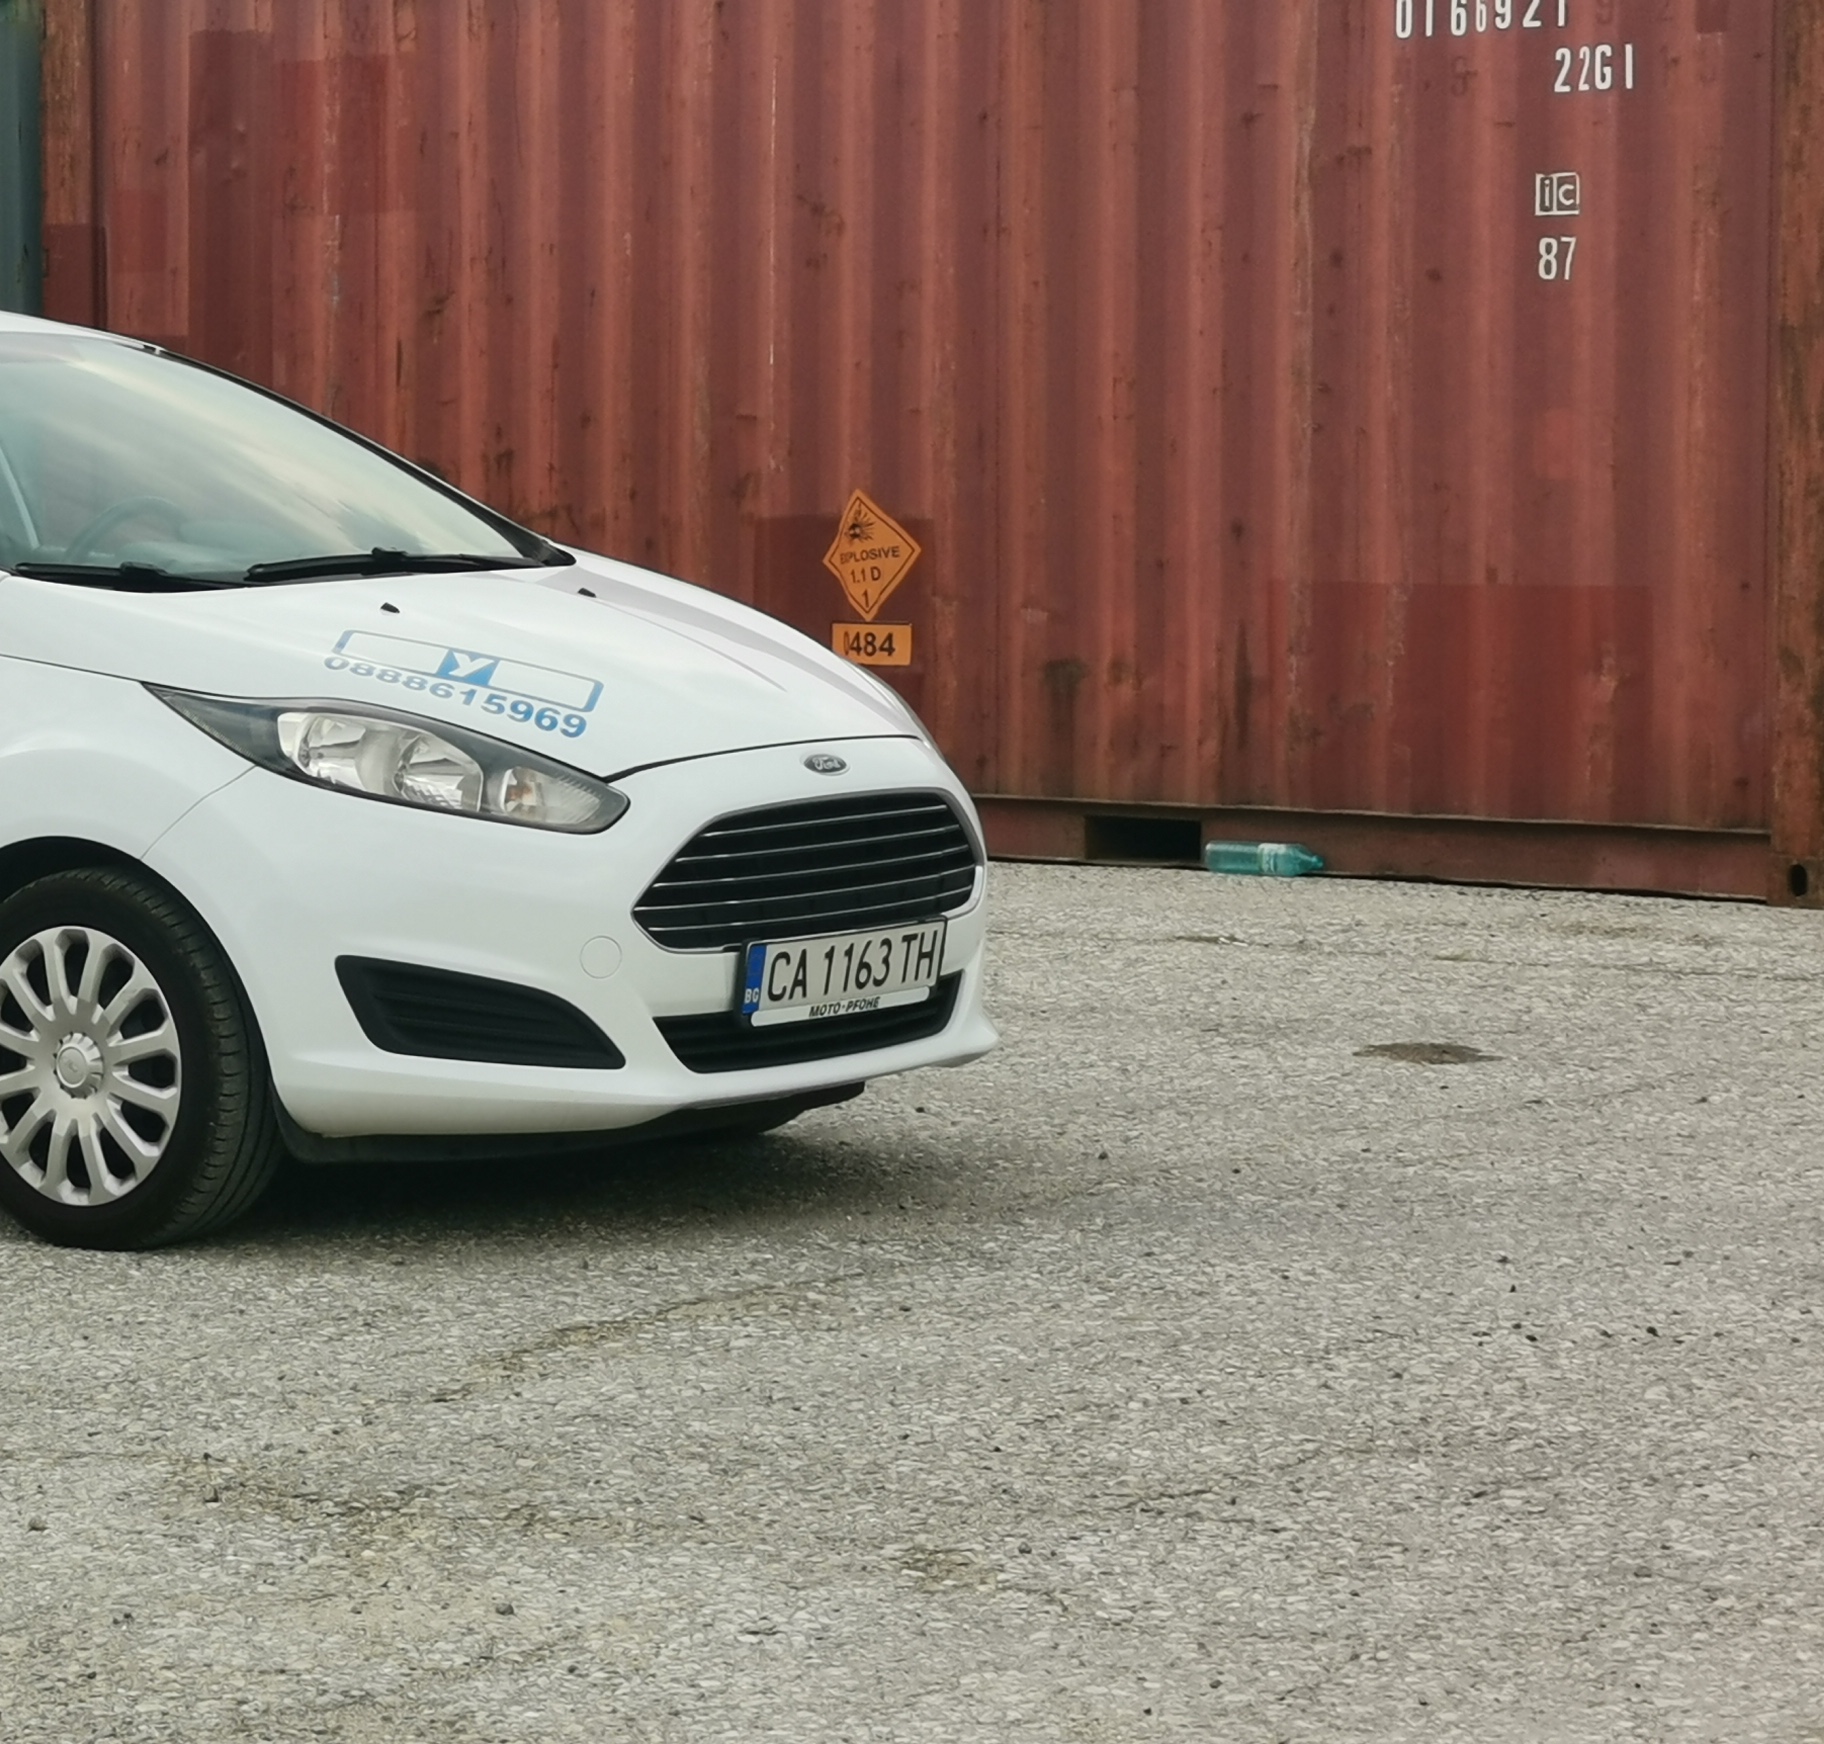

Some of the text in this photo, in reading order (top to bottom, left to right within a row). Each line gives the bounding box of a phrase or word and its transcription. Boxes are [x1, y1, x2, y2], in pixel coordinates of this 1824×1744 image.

[1538, 237, 1577, 280] 87
[861, 588, 870, 608] 1
[323, 655, 588, 739] 0888615969
[744, 929, 939, 1003] BG CA 1163 TH
